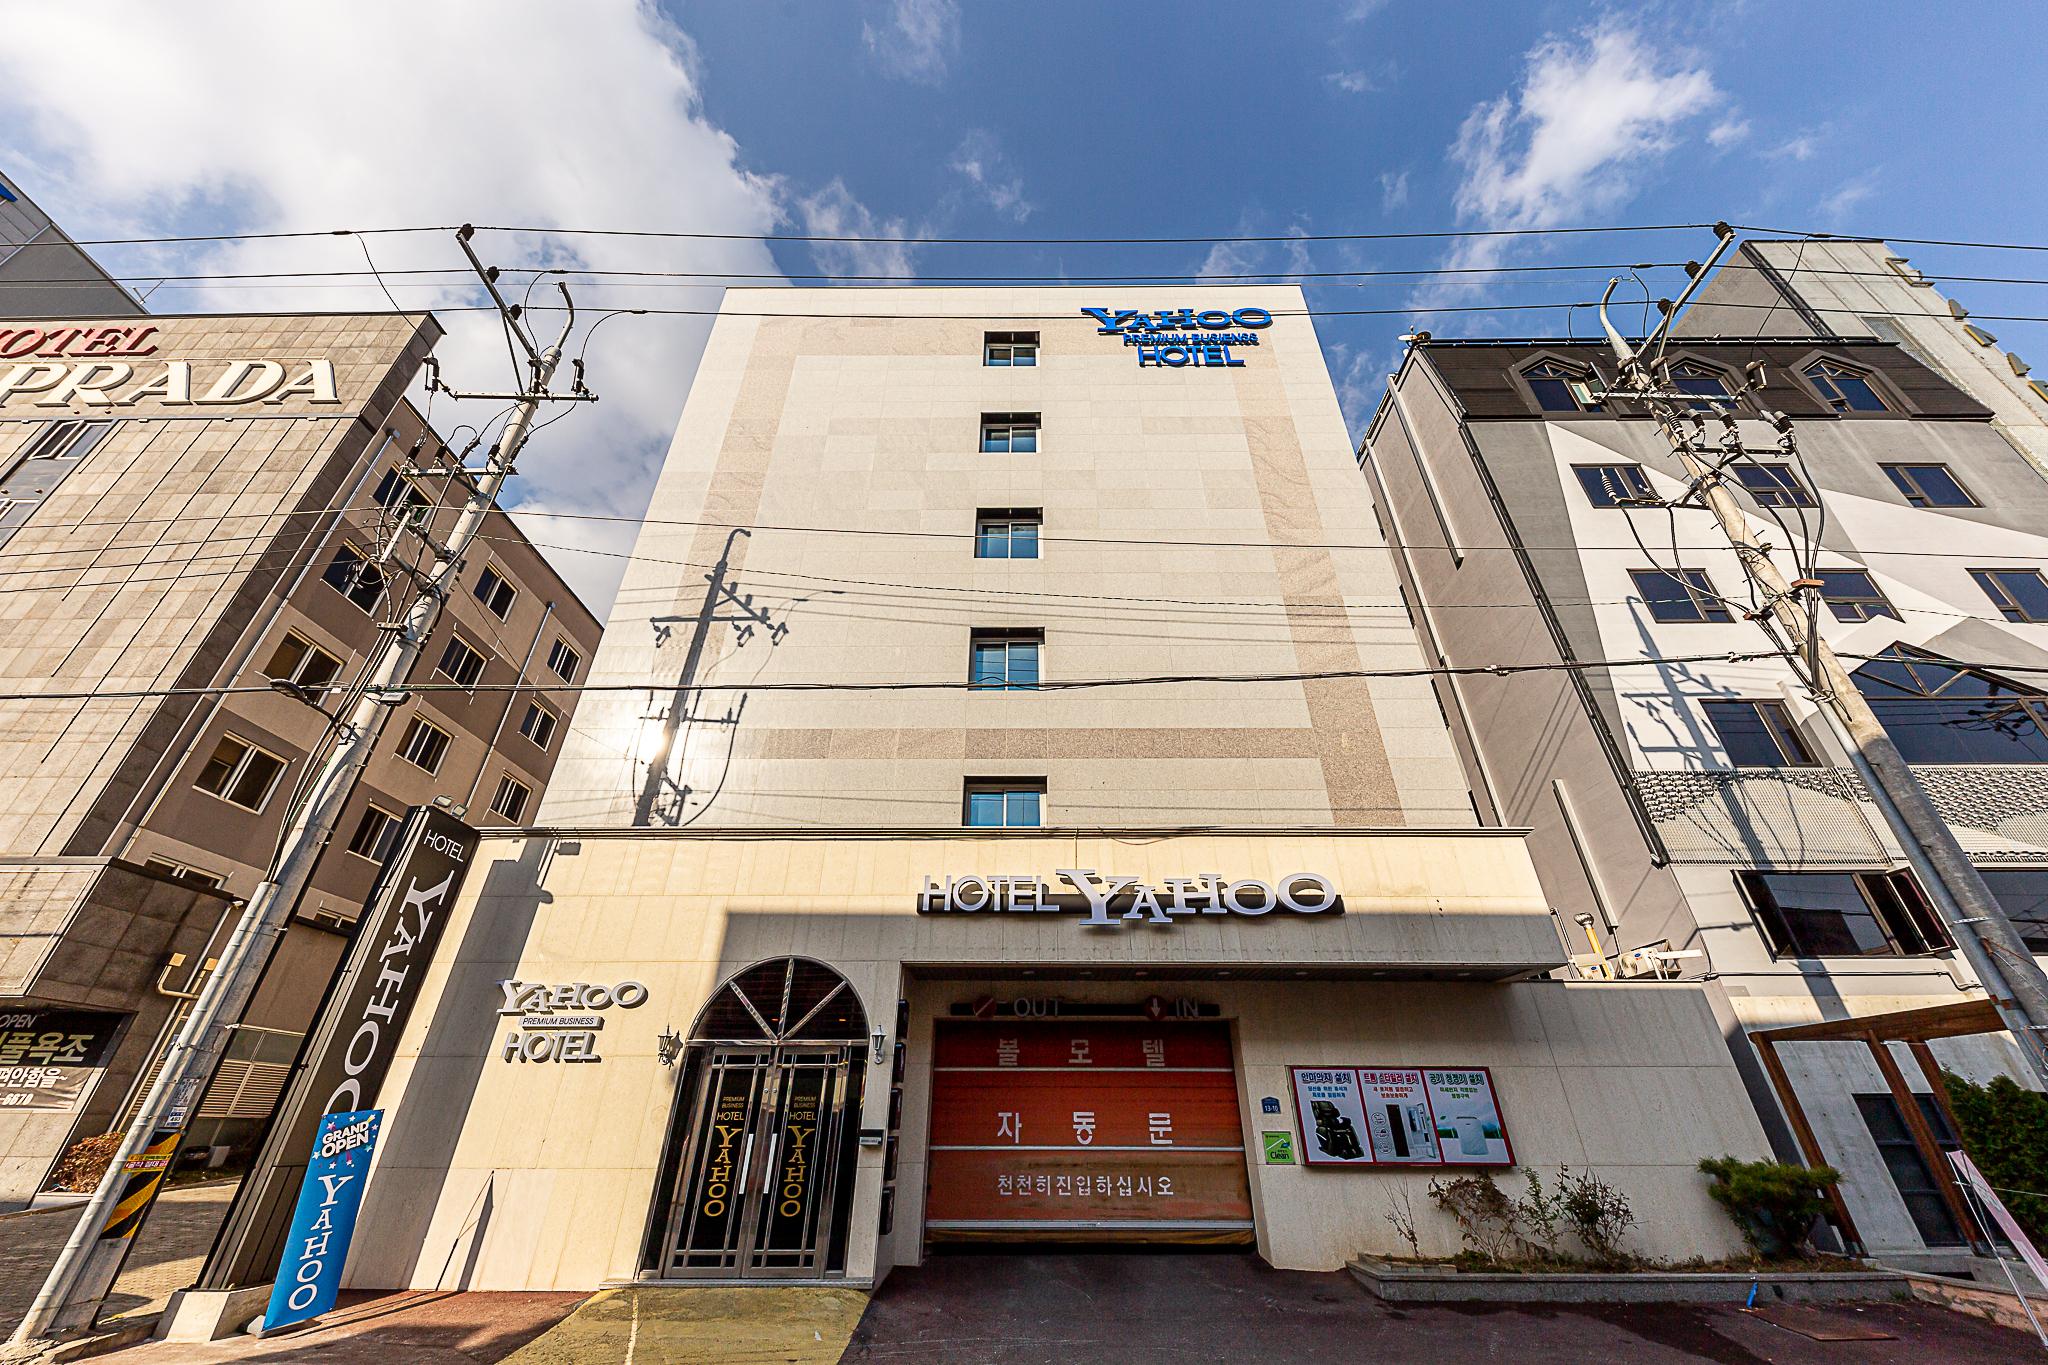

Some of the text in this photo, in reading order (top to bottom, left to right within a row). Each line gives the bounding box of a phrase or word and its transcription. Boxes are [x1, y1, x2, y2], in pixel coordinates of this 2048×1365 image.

[1081, 307, 1272, 332] YAHOO
[0, 326, 158, 358] OTEL
[1123, 333, 1189, 344] PREMIUM
[1138, 345, 1245, 366] HOTEL
[0, 360, 342, 407] PRADA
[423, 829, 464, 863] HOTEL
[922, 868, 1338, 926] HOTEL YAHOO
[496, 980, 649, 1016] YAHOO
[1013, 997, 1199, 1018] OUT IN
[0, 1014, 37, 1028] OPEN
[523, 1017, 594, 1026] PREMIUM BUSINESS
[0, 1031, 95, 1065] 풀욕조
[502, 1032, 601, 1063] HOTEL
[1301, 1072, 1352, 1083] 안마의자 설치
[1405, 1073, 1419, 1084] 설치
[1429, 1073, 1484, 1085] 공기 청정기 설치
[0, 1092, 34, 1105] -6670
[716, 1111, 744, 1121] HOTEL
[789, 1111, 816, 1121] HOTEL
[321, 1130, 369, 1158] OPEN
[322, 1121, 369, 1145] GRAND
[1270, 1151, 1289, 1160] Clean
[704, 1125, 743, 1217] YAHOO
[780, 1125, 815, 1217] YAHOO
[288, 1174, 354, 1311] YAHOO
